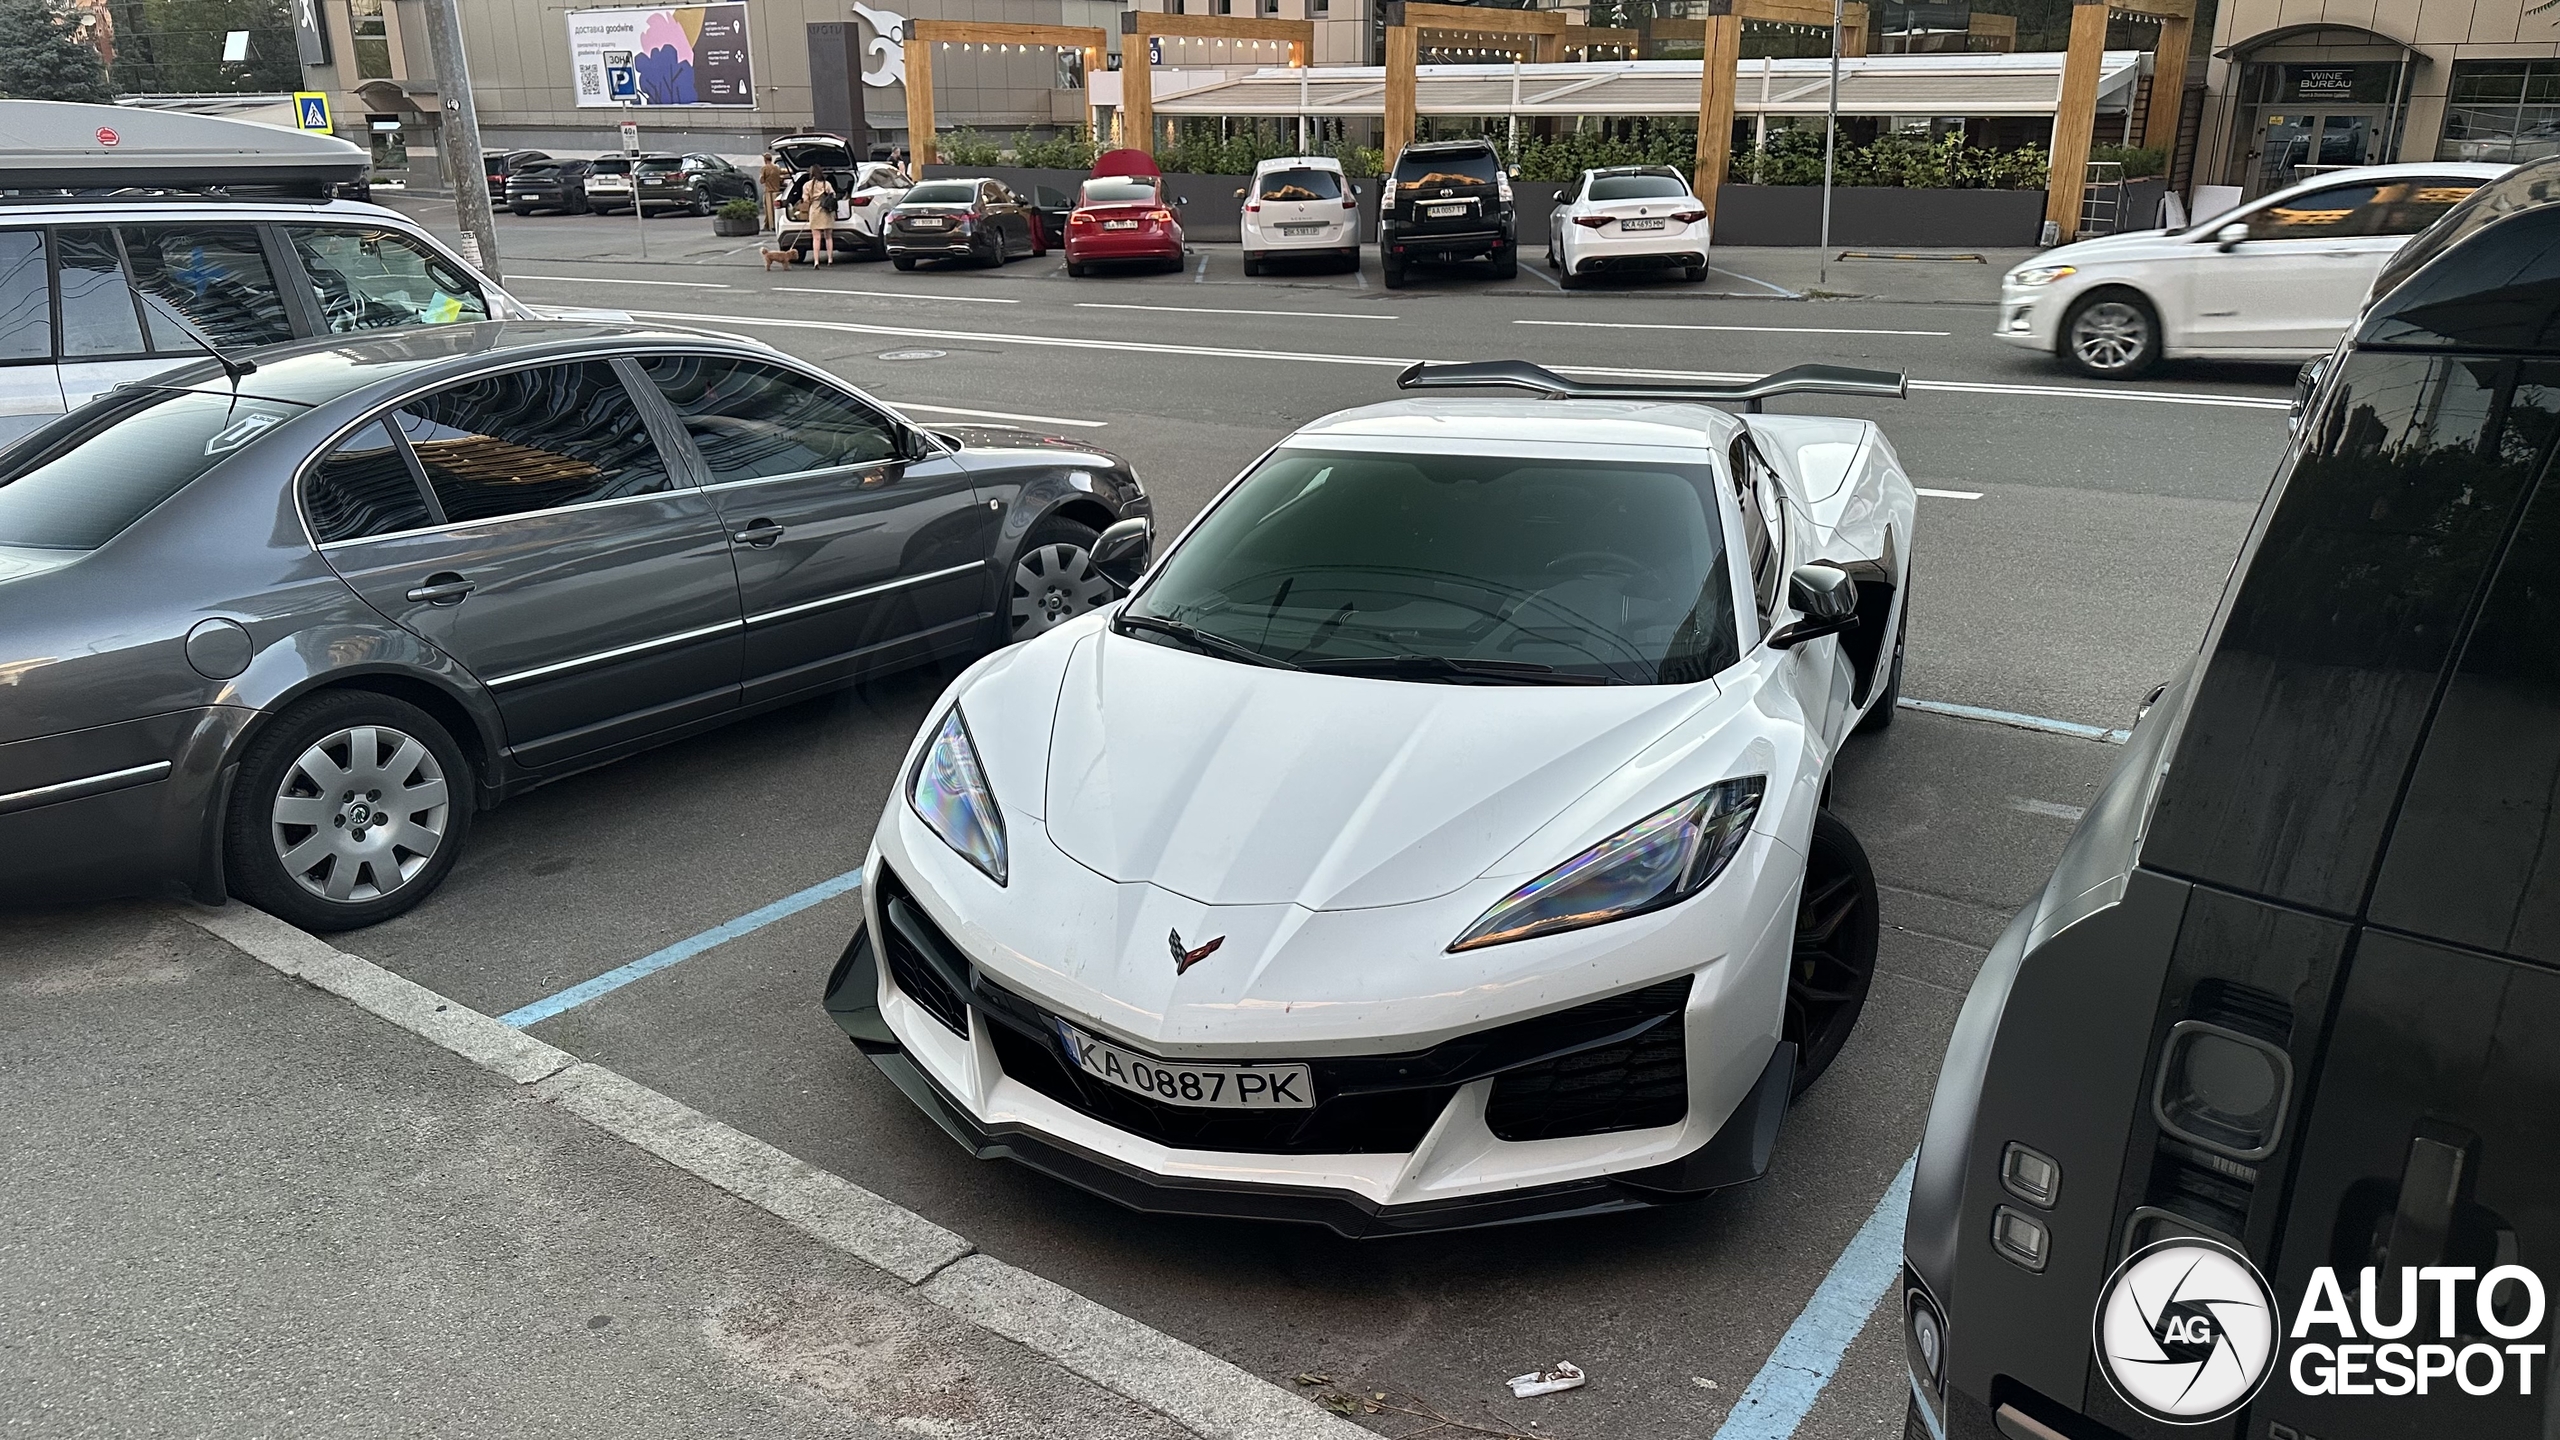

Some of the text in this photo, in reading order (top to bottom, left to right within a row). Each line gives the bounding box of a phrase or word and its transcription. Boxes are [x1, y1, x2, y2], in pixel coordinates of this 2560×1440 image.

[575, 23, 634, 35] доставка goodwine
[609, 55, 631, 64] ЗОНА
[2311, 72, 2344, 80] WINE
[2300, 80, 2352, 88] BUREAU
[1075, 1035, 1304, 1103] KA 0887 PK
